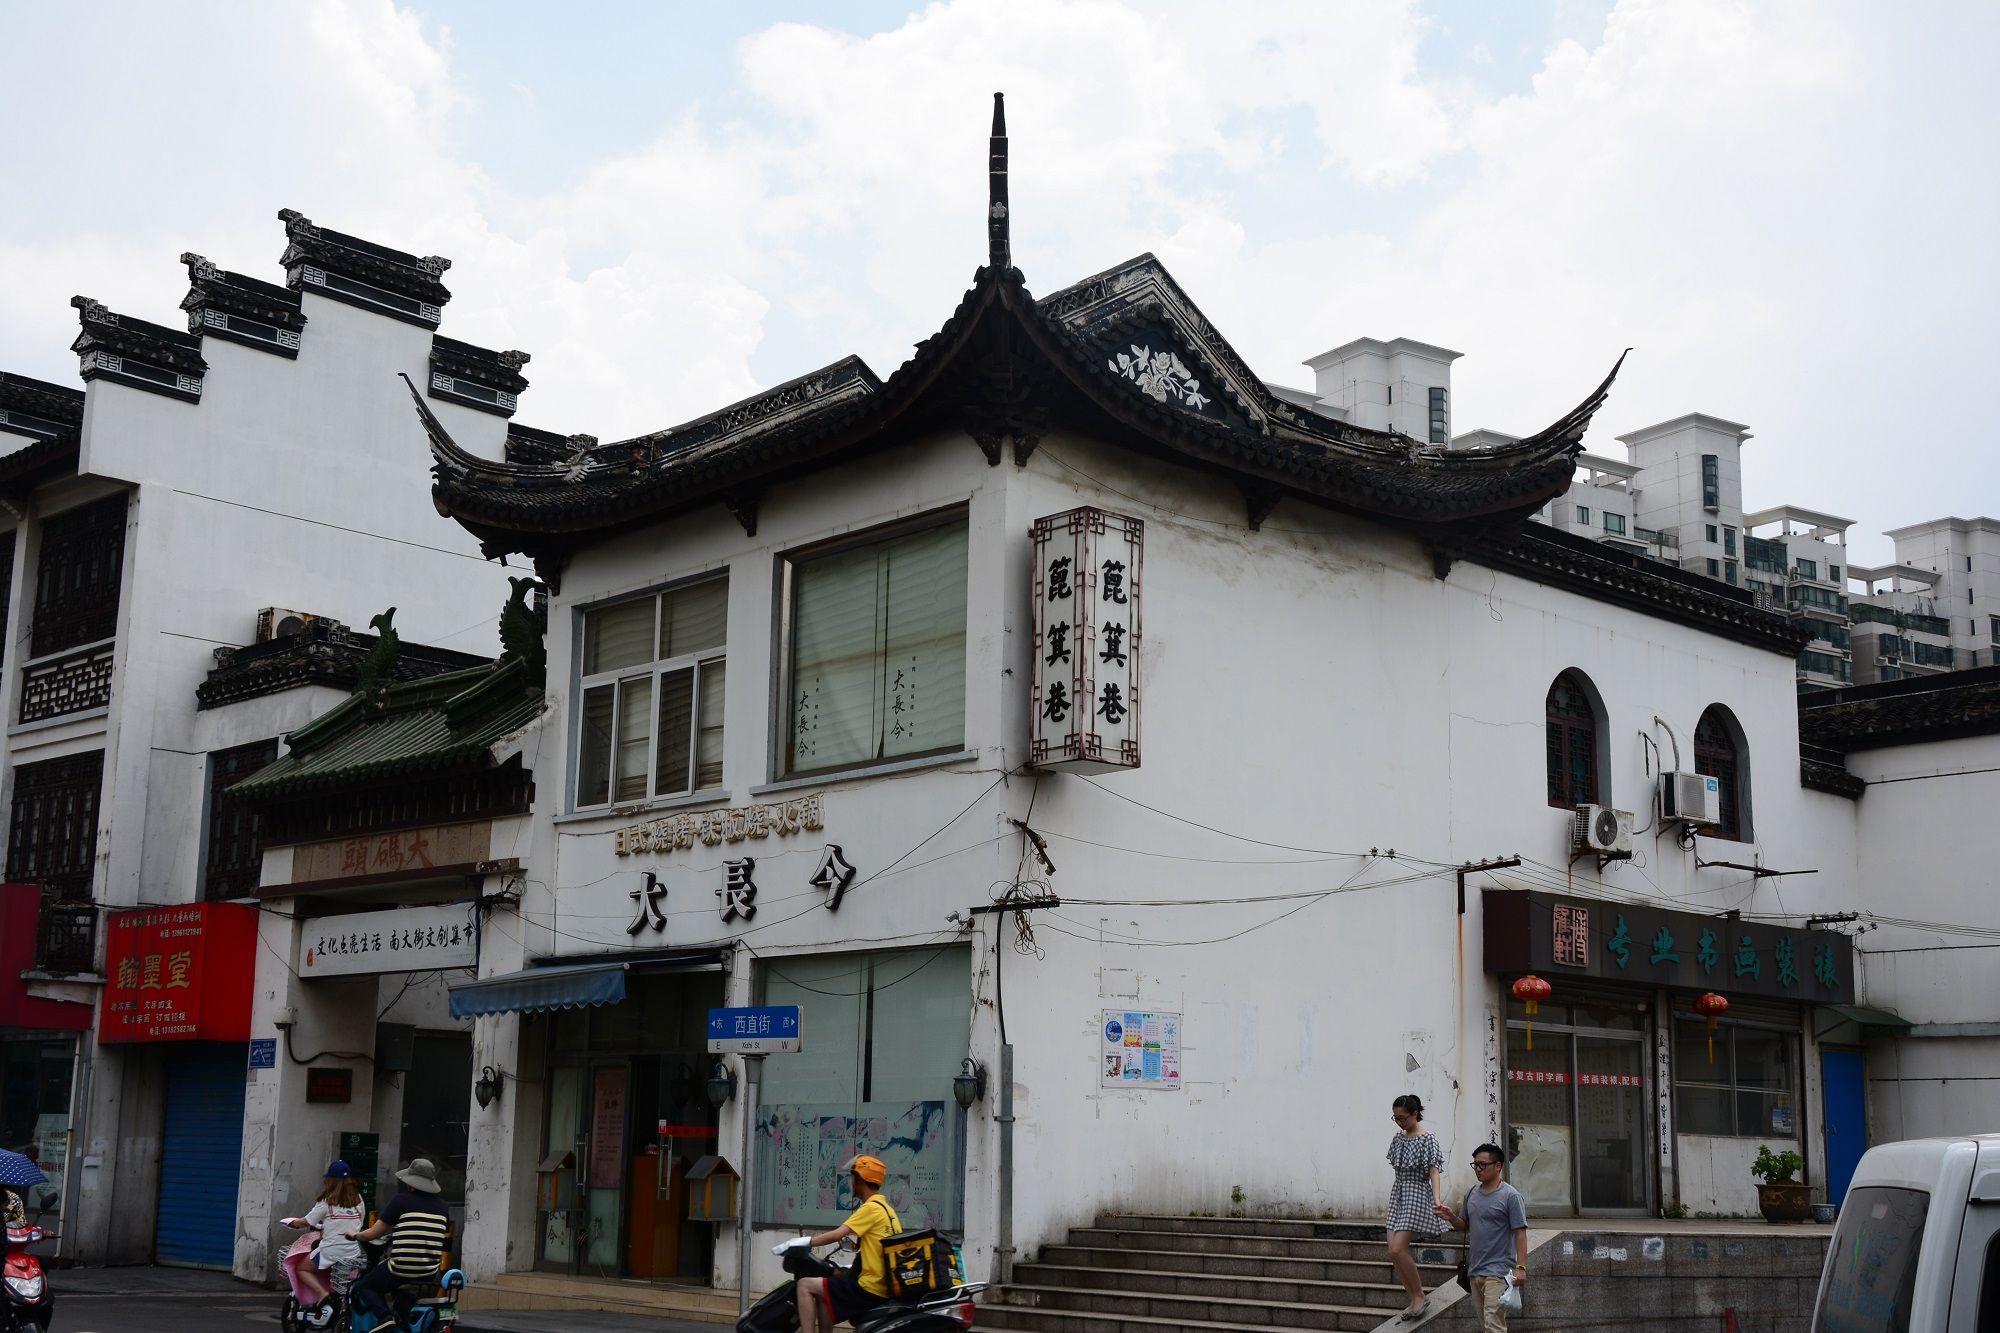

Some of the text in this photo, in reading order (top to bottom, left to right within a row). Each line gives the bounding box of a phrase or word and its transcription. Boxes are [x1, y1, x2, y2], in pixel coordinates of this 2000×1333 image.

[316, 933, 381, 956] 文化点亮生活
[1607, 911, 1840, 989] 专业书画装裱
[116, 950, 192, 991] 翰墨堂
[716, 1014, 790, 1034] 东 西直街 西
[716, 1041, 721, 1049] E
[781, 1041, 789, 1050] W
[1507, 1070, 1564, 1083] 修复古旧字画
